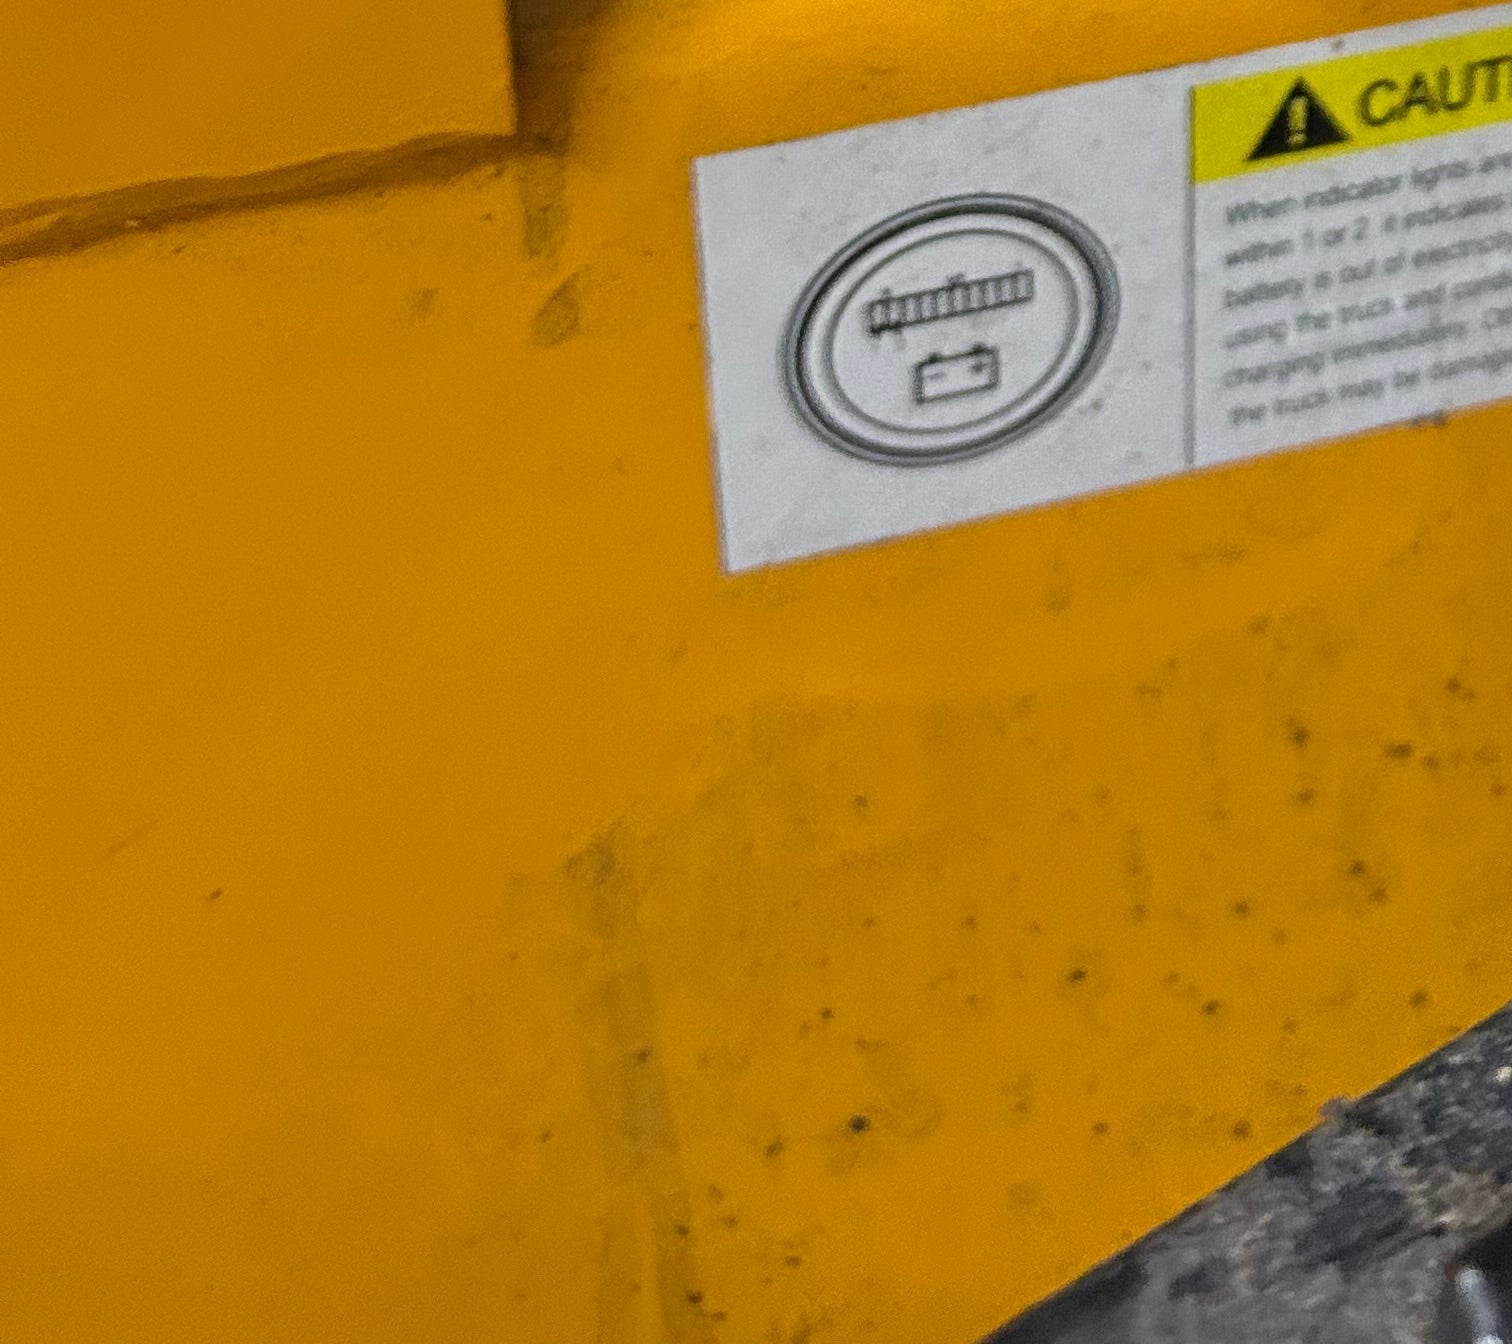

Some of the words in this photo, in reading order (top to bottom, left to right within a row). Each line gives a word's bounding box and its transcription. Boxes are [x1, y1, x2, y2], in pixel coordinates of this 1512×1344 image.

[1226, 198, 1297, 224] When
[1303, 174, 1403, 209] indicator
[1323, 226, 1347, 247] or
[1225, 277, 1305, 310] battery
[1339, 259, 1377, 284] out
[1296, 312, 1331, 332] the
